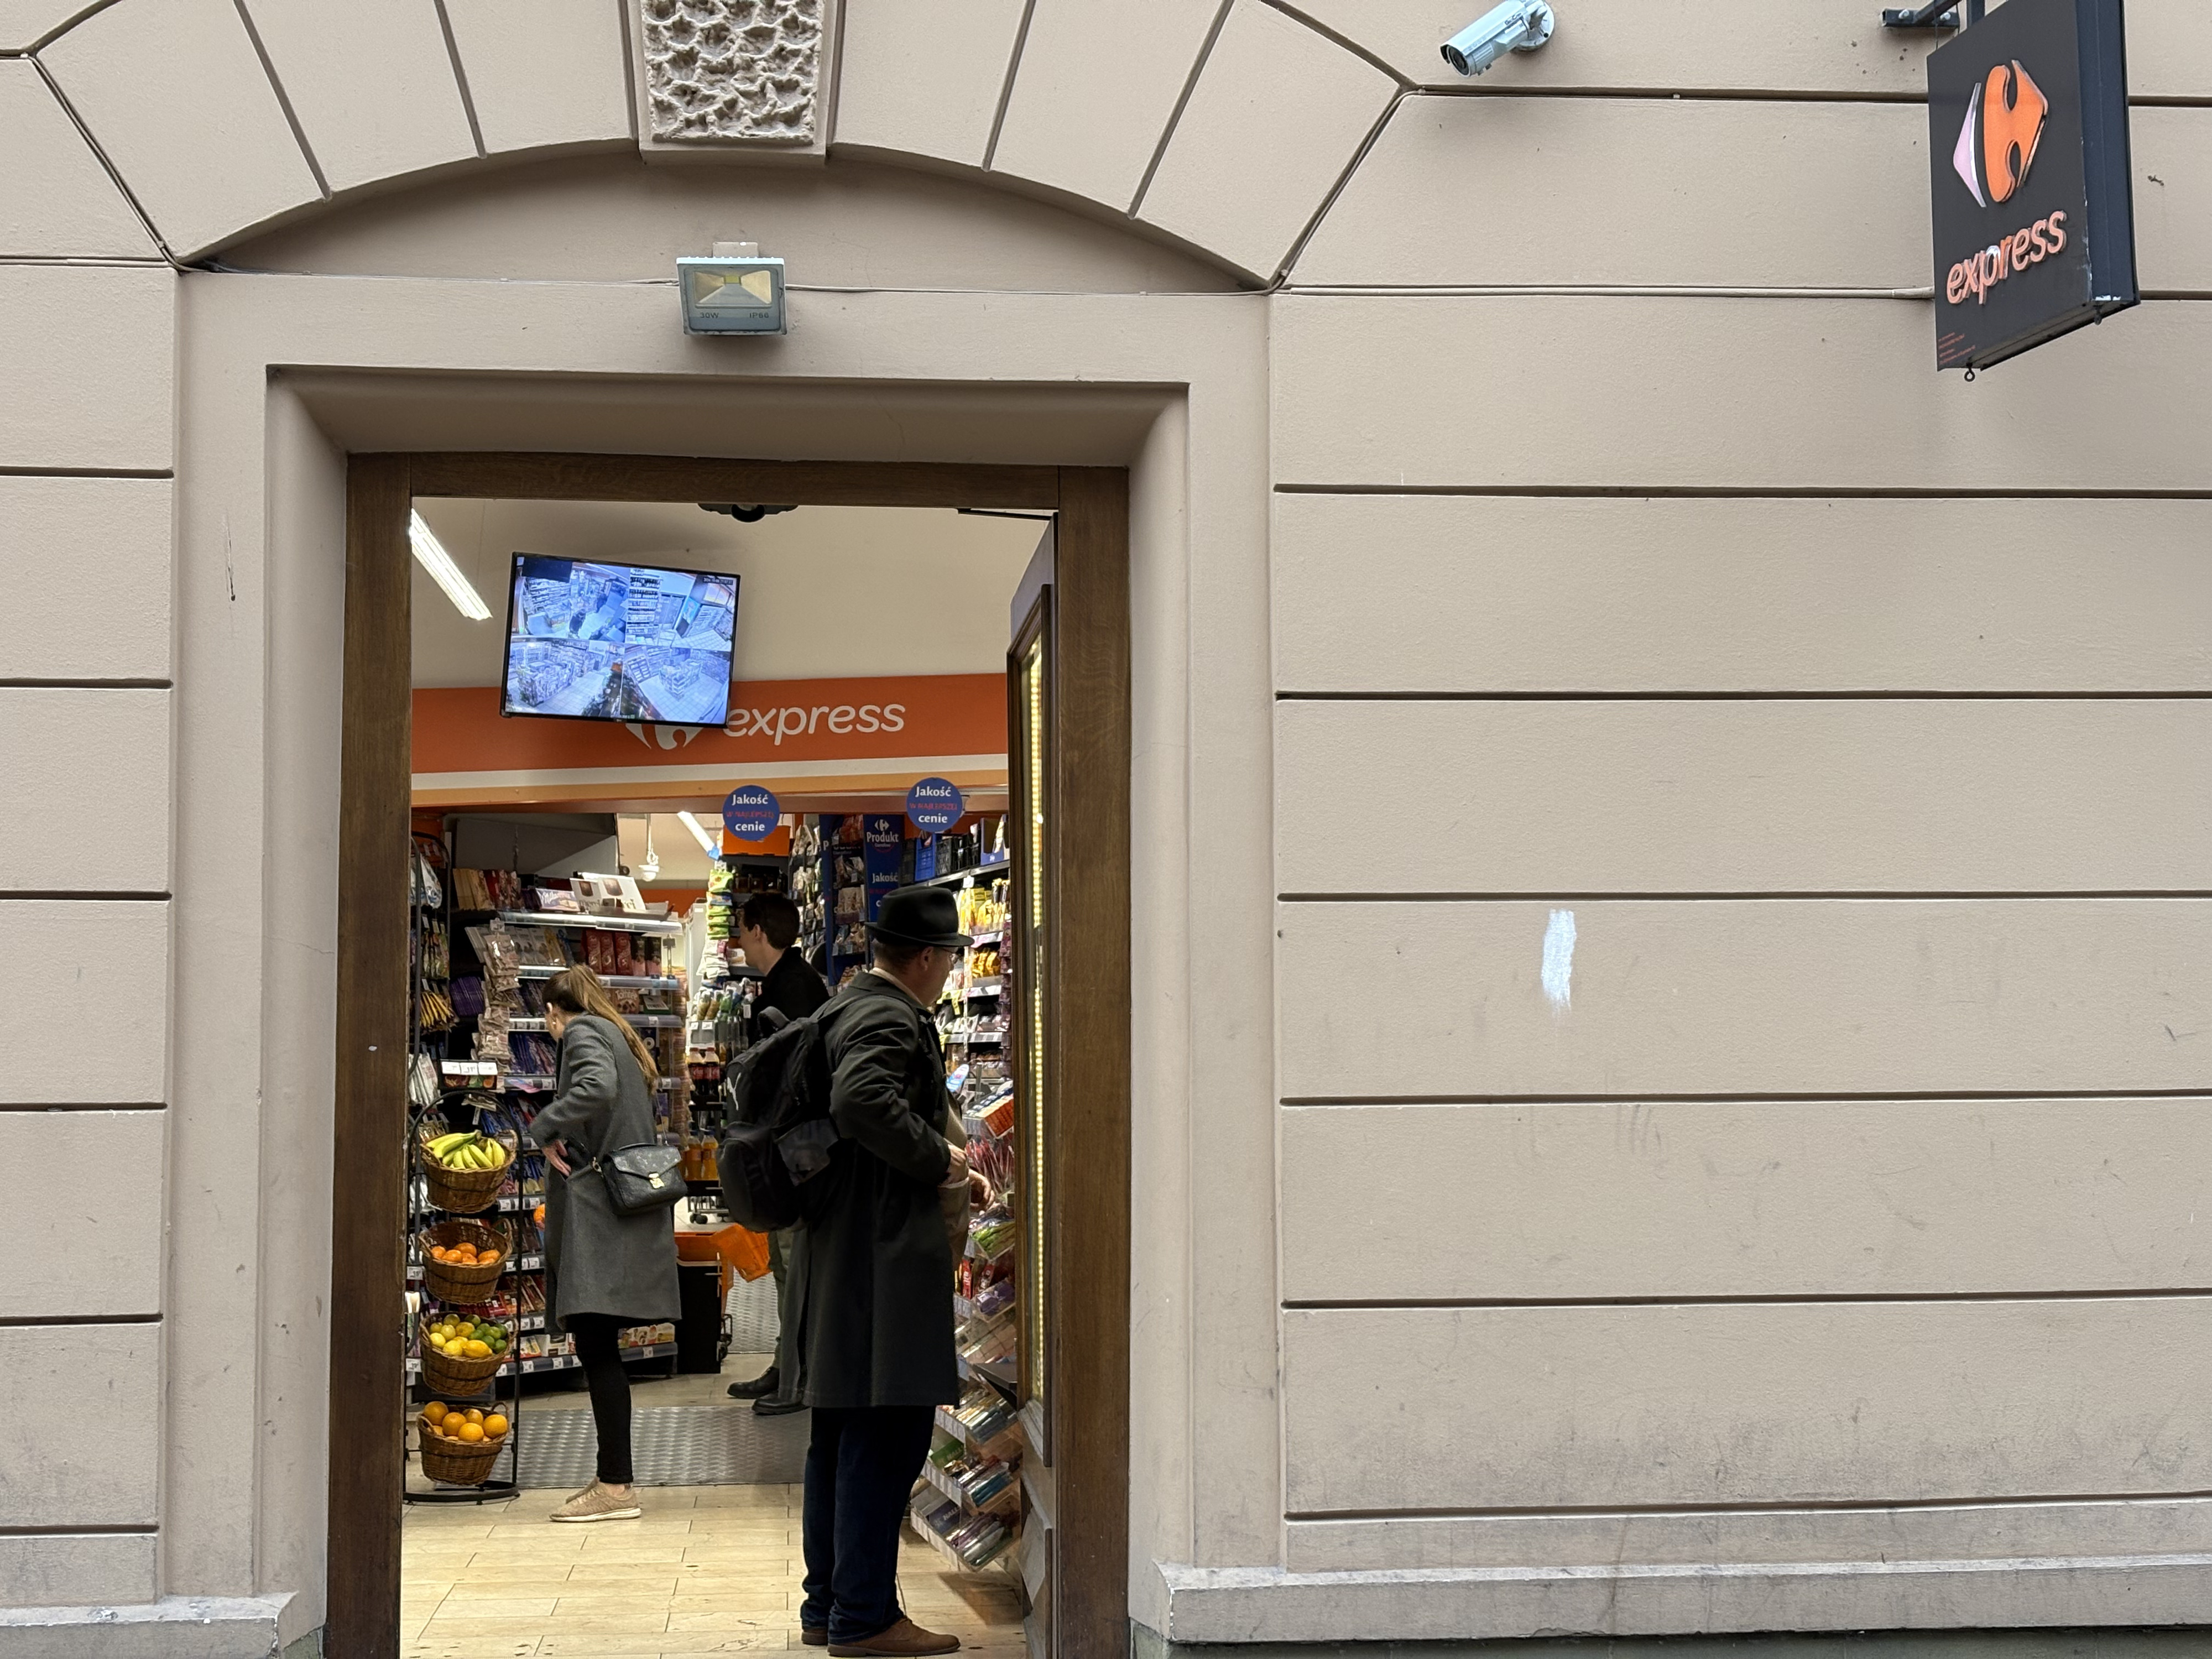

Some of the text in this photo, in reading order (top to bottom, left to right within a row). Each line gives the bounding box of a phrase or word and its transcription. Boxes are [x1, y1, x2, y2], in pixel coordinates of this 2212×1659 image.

[1946, 210, 2067, 305] express
[723, 704, 905, 745] express
[915, 786, 951, 797] Jakość
[732, 794, 768, 806] Jakość
[919, 813, 948, 823] cenie
[735, 821, 765, 831] cenie
[866, 831, 899, 842] Produkt
[872, 872, 898, 883] Jakość
